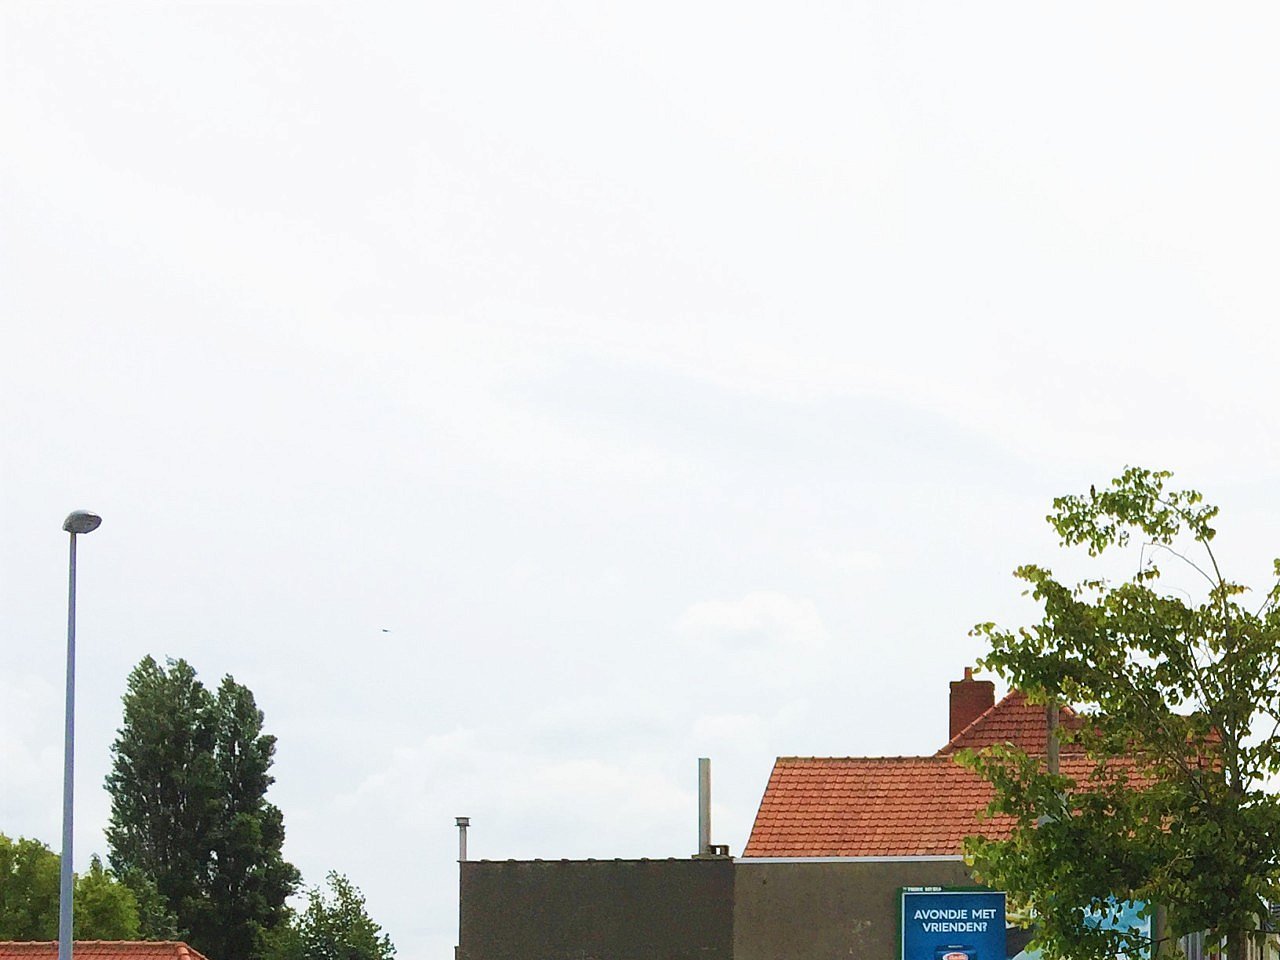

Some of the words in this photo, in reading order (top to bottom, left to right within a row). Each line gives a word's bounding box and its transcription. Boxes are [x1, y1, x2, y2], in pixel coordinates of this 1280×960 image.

[914, 909, 968, 920] AVONDJE
[972, 909, 997, 919] MET
[922, 922, 988, 932] VRIENDEN?
